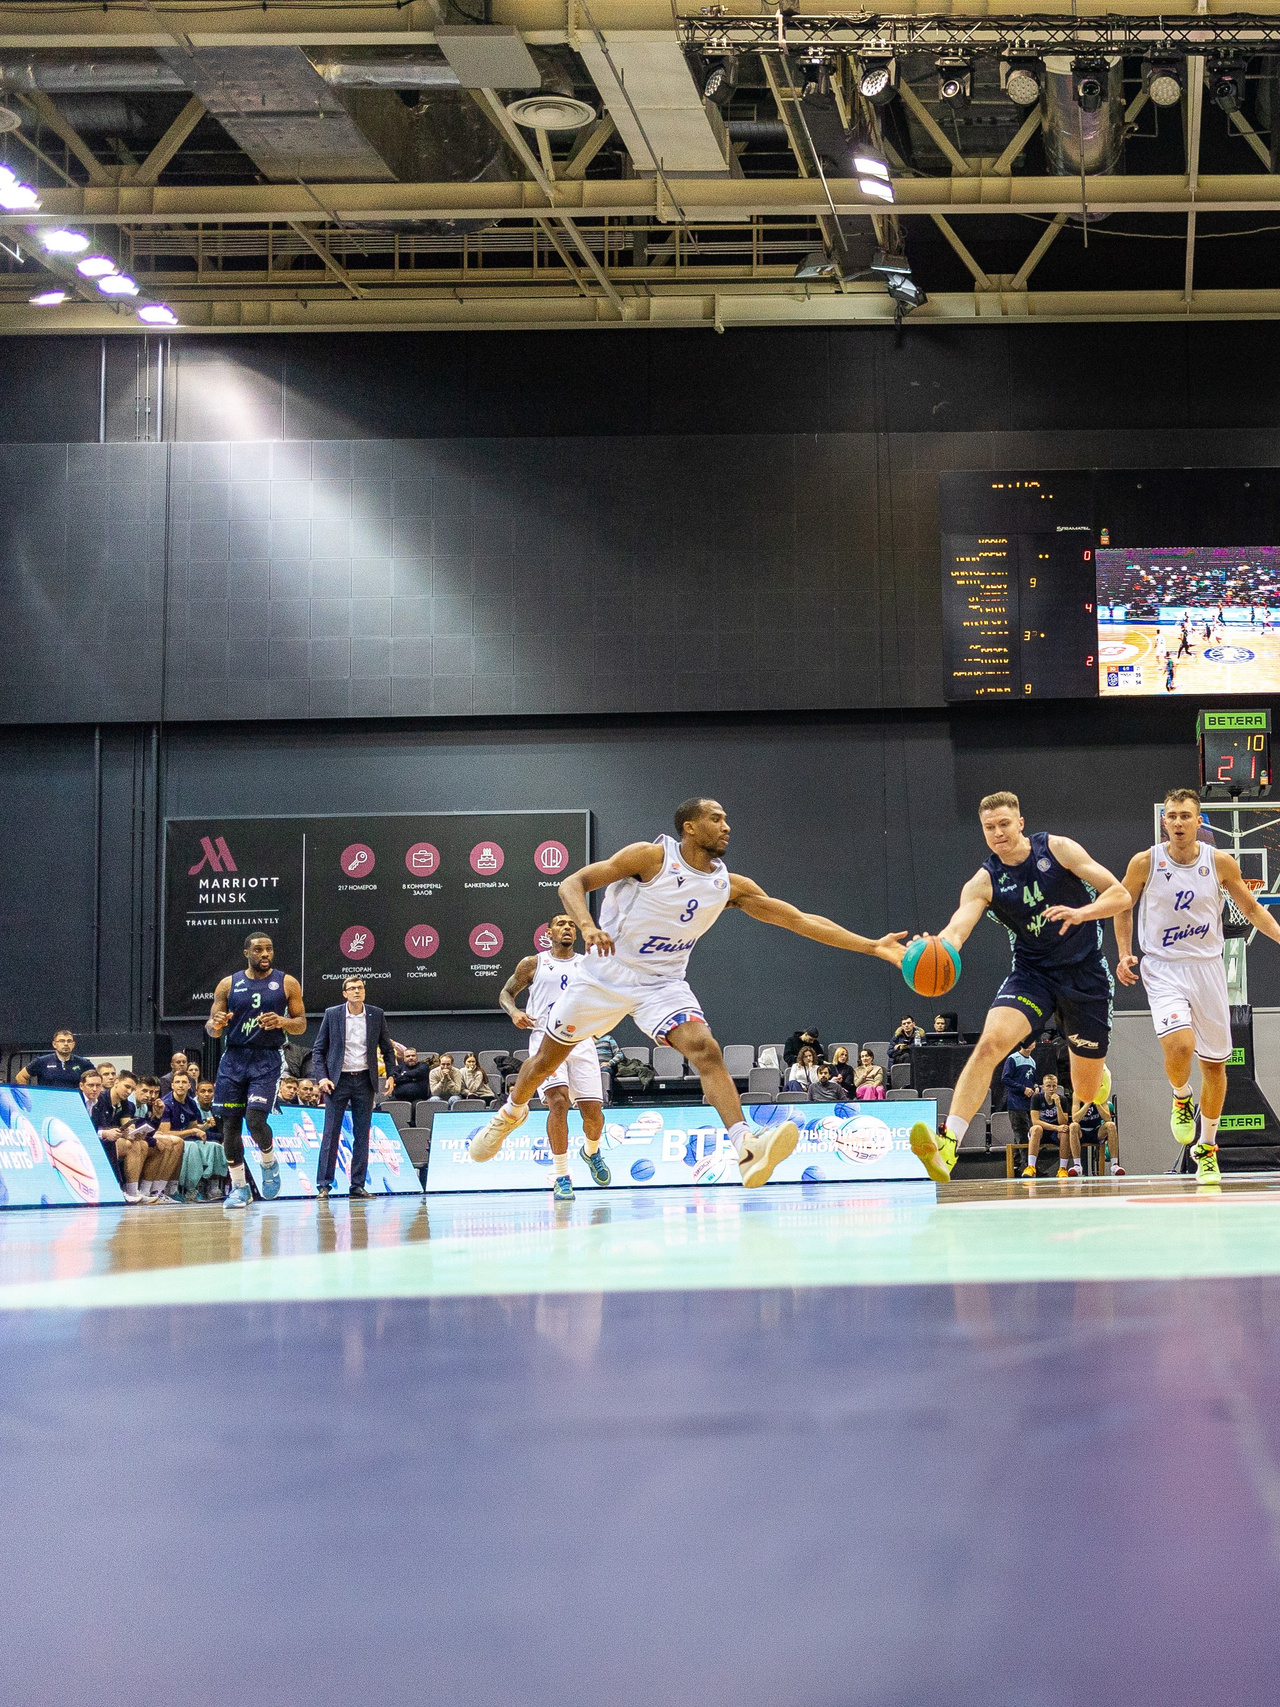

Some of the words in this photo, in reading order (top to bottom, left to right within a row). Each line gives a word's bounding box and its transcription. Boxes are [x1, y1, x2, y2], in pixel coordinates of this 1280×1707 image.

[1083, 550, 1091, 560] 0
[1030, 578, 1037, 587] 9
[1085, 604, 1092, 613] 4
[1086, 656, 1094, 666] 2
[1024, 684, 1032, 694] 9
[199, 877, 279, 889] MARRIOTT
[199, 893, 246, 904] MINSK
[1022, 881, 1045, 907] 44
[1173, 890, 1195, 911] 12
[679, 899, 698, 922] 3
[1162, 922, 1210, 947] Enisey
[411, 936, 434, 947] VIP
[322, 972, 391, 980] СРЕДИЗЕМНОМОРСКОЙ
[560, 974, 568, 990] 8
[251, 993, 261, 1009] 3
[799, 1126, 853, 1141] ЛЬНЫЙ
